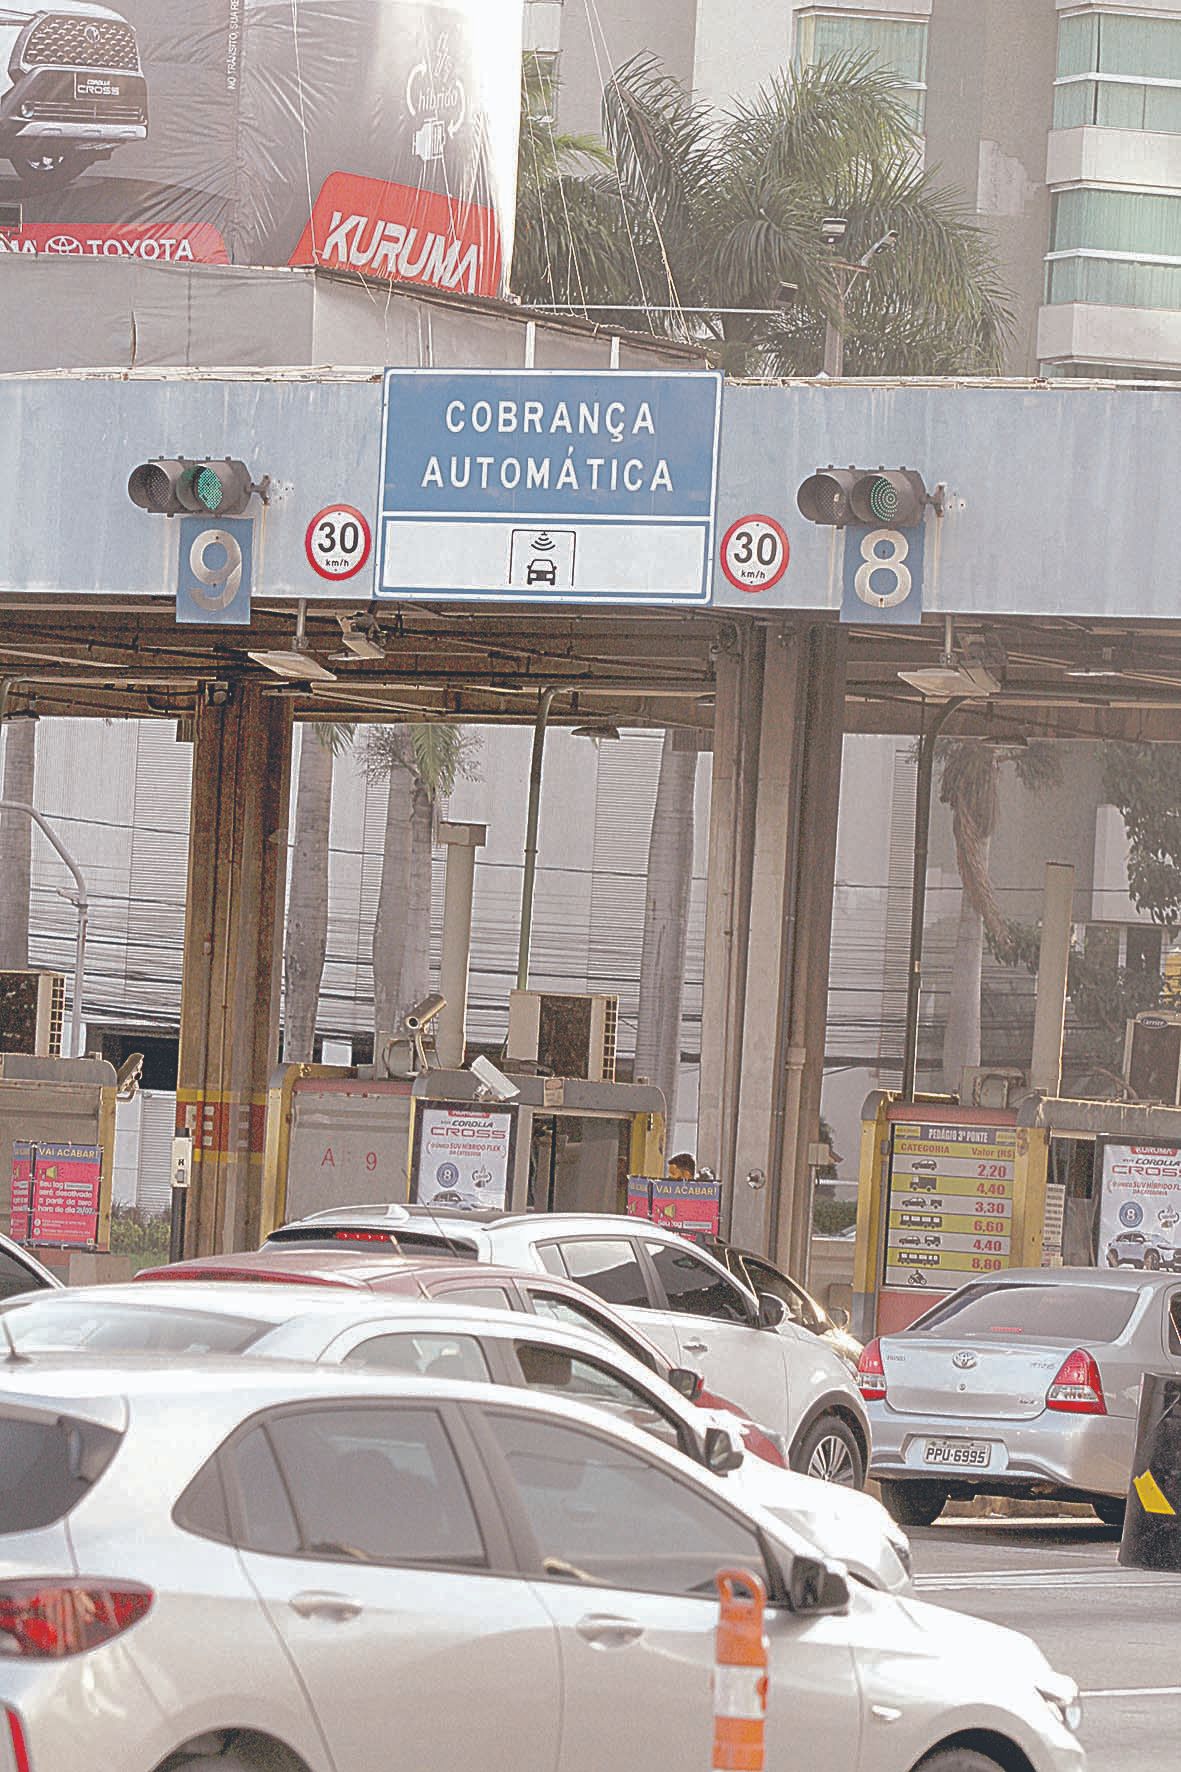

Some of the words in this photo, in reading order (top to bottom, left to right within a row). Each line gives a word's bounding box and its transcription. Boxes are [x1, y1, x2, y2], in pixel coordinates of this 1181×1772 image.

[77, 84, 120, 96] CROSS
[87, 239, 194, 262] TOYOTA
[322, 211, 481, 295] KURUMA
[445, 400, 656, 442] COBRANÇA
[421, 446, 674, 492] AUTOMÁTICA
[318, 522, 359, 554] 30
[734, 531, 777, 566] 30
[188, 529, 243, 611] 9
[325, 559, 350, 567] km/h
[854, 528, 912, 608] 8
[741, 570, 766, 579] km/h
[452, 1120, 494, 1128] COROLLA
[430, 1126, 507, 1140] CROSS
[928, 1127, 957, 1140] PEDÁGIO
[966, 1132, 988, 1143] PONTE
[40, 1147, 54, 1156] VAI
[57, 1148, 98, 1159] ACABAR!
[901, 1143, 950, 1154] CATEGORIA
[972, 1147, 994, 1157] Valor
[321, 1147, 336, 1167] A
[366, 1151, 377, 1171] 9
[1135, 1158, 1181, 1166] COROLLA
[1111, 1164, 1181, 1177] CROS
[656, 1185, 672, 1194] VAI
[674, 1185, 717, 1197] ACABAR!
